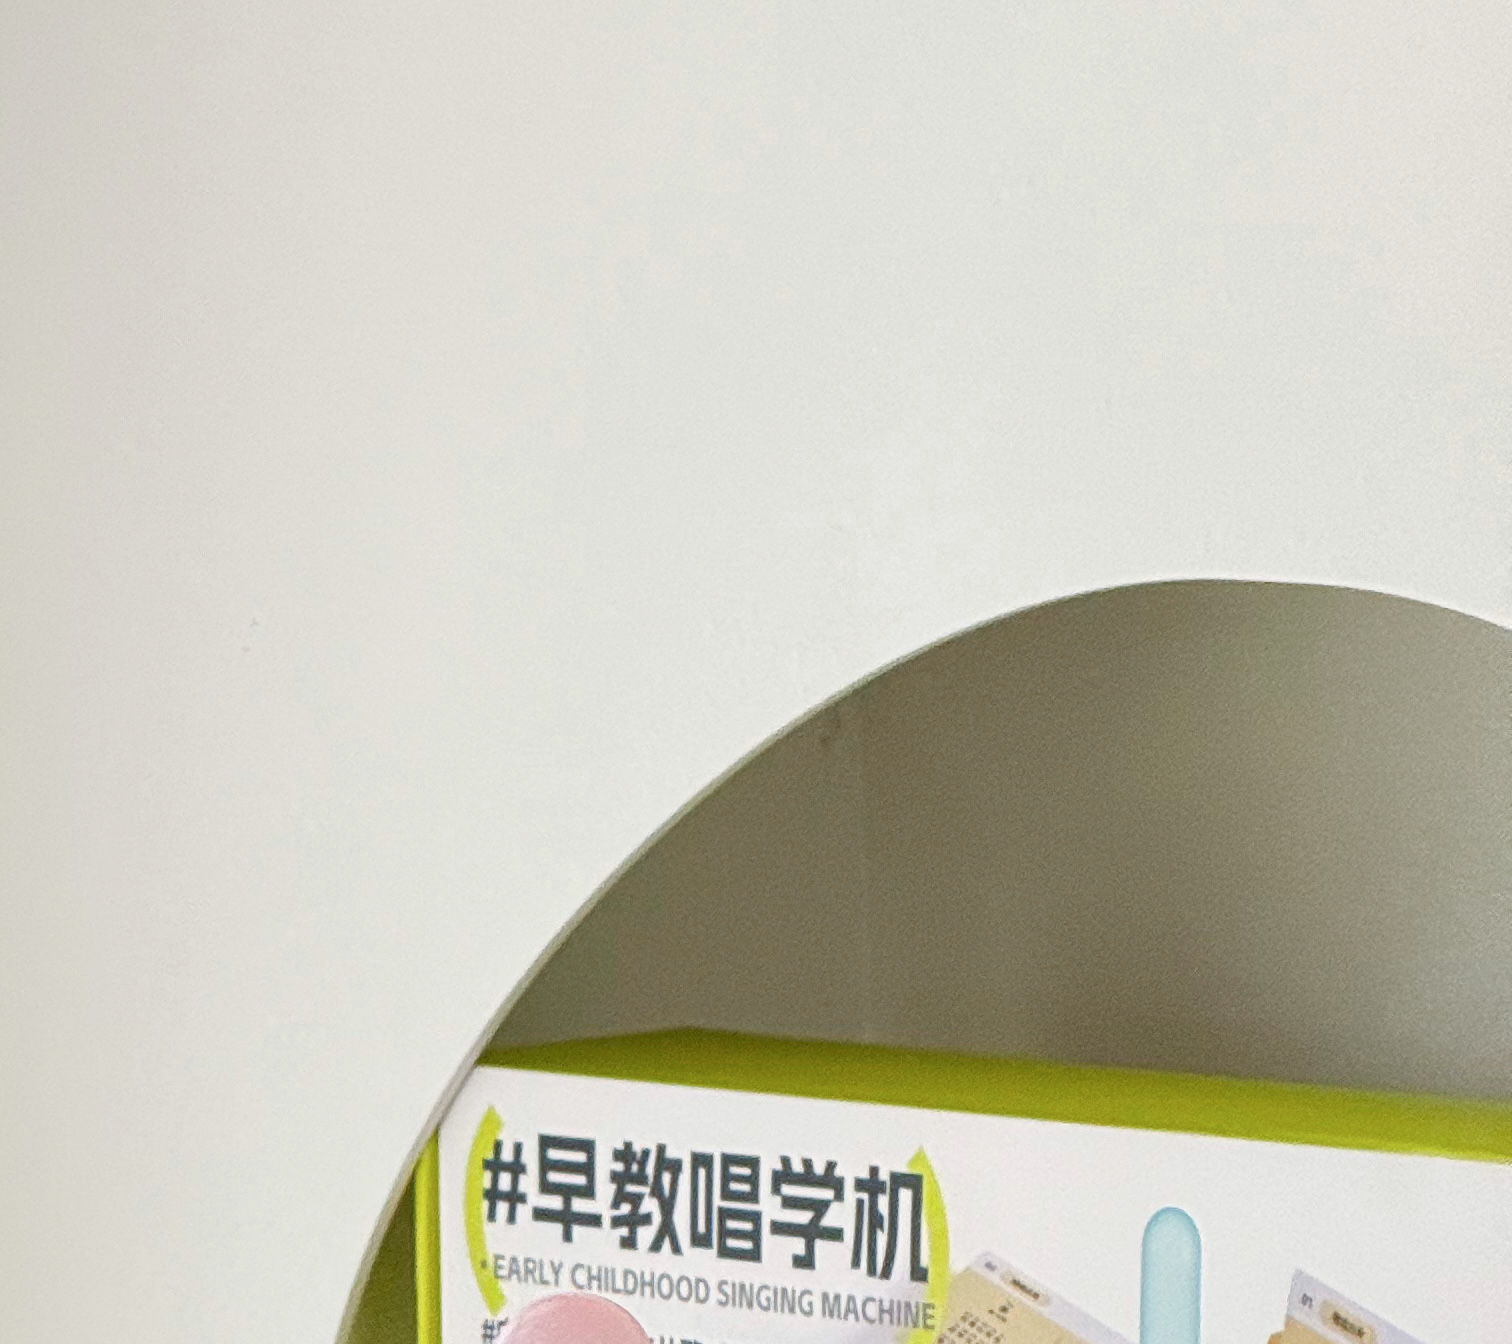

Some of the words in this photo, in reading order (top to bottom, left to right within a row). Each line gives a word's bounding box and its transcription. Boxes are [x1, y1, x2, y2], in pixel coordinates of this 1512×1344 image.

[481, 1132, 929, 1284] #早教唱学机
[570, 1262, 710, 1304] CHILDHOOD
[716, 1279, 814, 1316] SINGING
[820, 1289, 936, 1331] MACHINE
